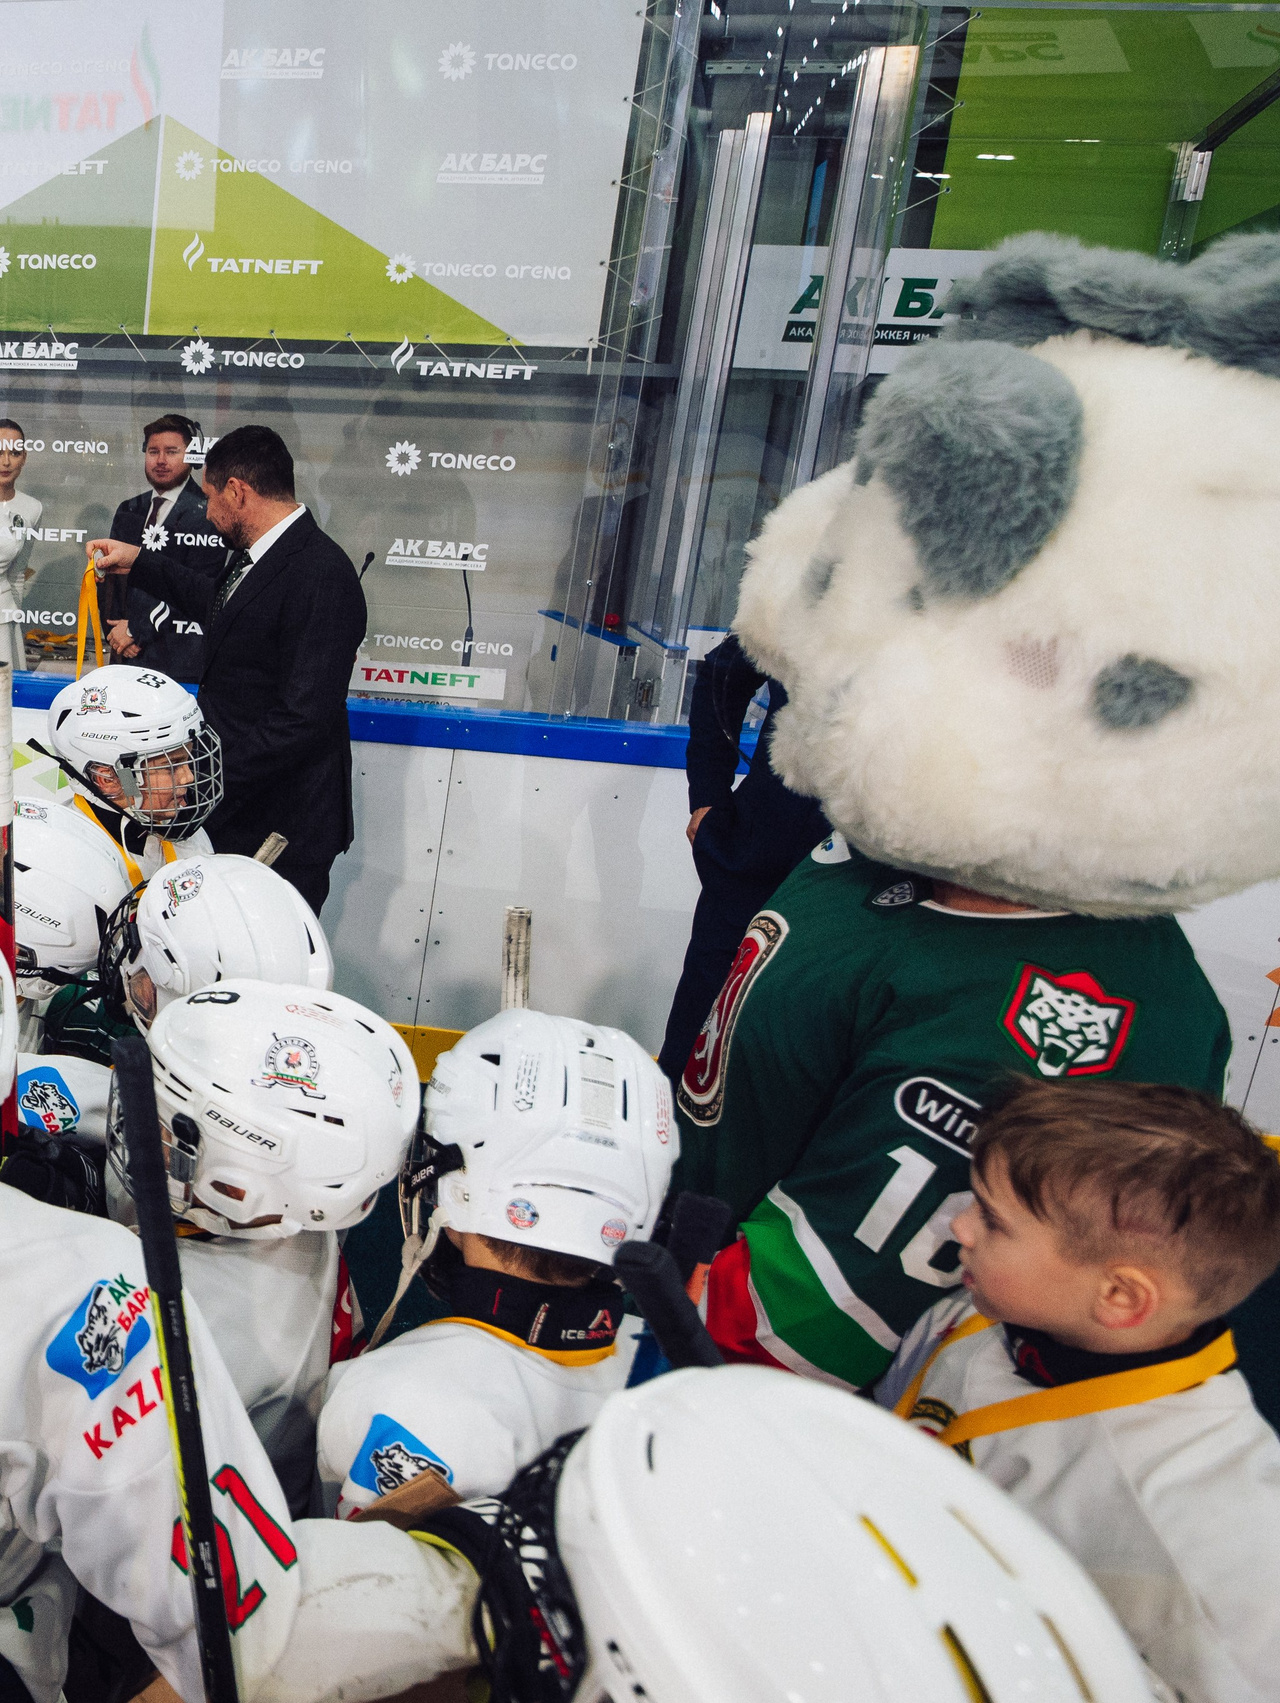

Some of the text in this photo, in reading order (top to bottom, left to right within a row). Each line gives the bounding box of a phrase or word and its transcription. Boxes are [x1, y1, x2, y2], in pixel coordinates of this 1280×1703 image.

[222, 48, 326, 67] АК БАРС
[484, 53, 577, 71] TANECO
[210, 159, 281, 173] TANECO
[439, 153, 548, 173] АК БАРС
[17, 254, 97, 270] TANECO
[207, 258, 323, 275] TATNEFT
[423, 262, 496, 278] TANECO
[22, 342, 79, 359] БАРС
[221, 350, 305, 369] TANECO
[416, 361, 538, 380] TATNEFT
[428, 452, 516, 472] TANECO
[387, 538, 489, 560] АК БАРС
[373, 634, 443, 651] TANECO
[361, 667, 480, 688] TATNEFT
[81, 732, 118, 741] BAUER
[205, 1109, 277, 1150] BAUER
[108, 1273, 136, 1306] АК
